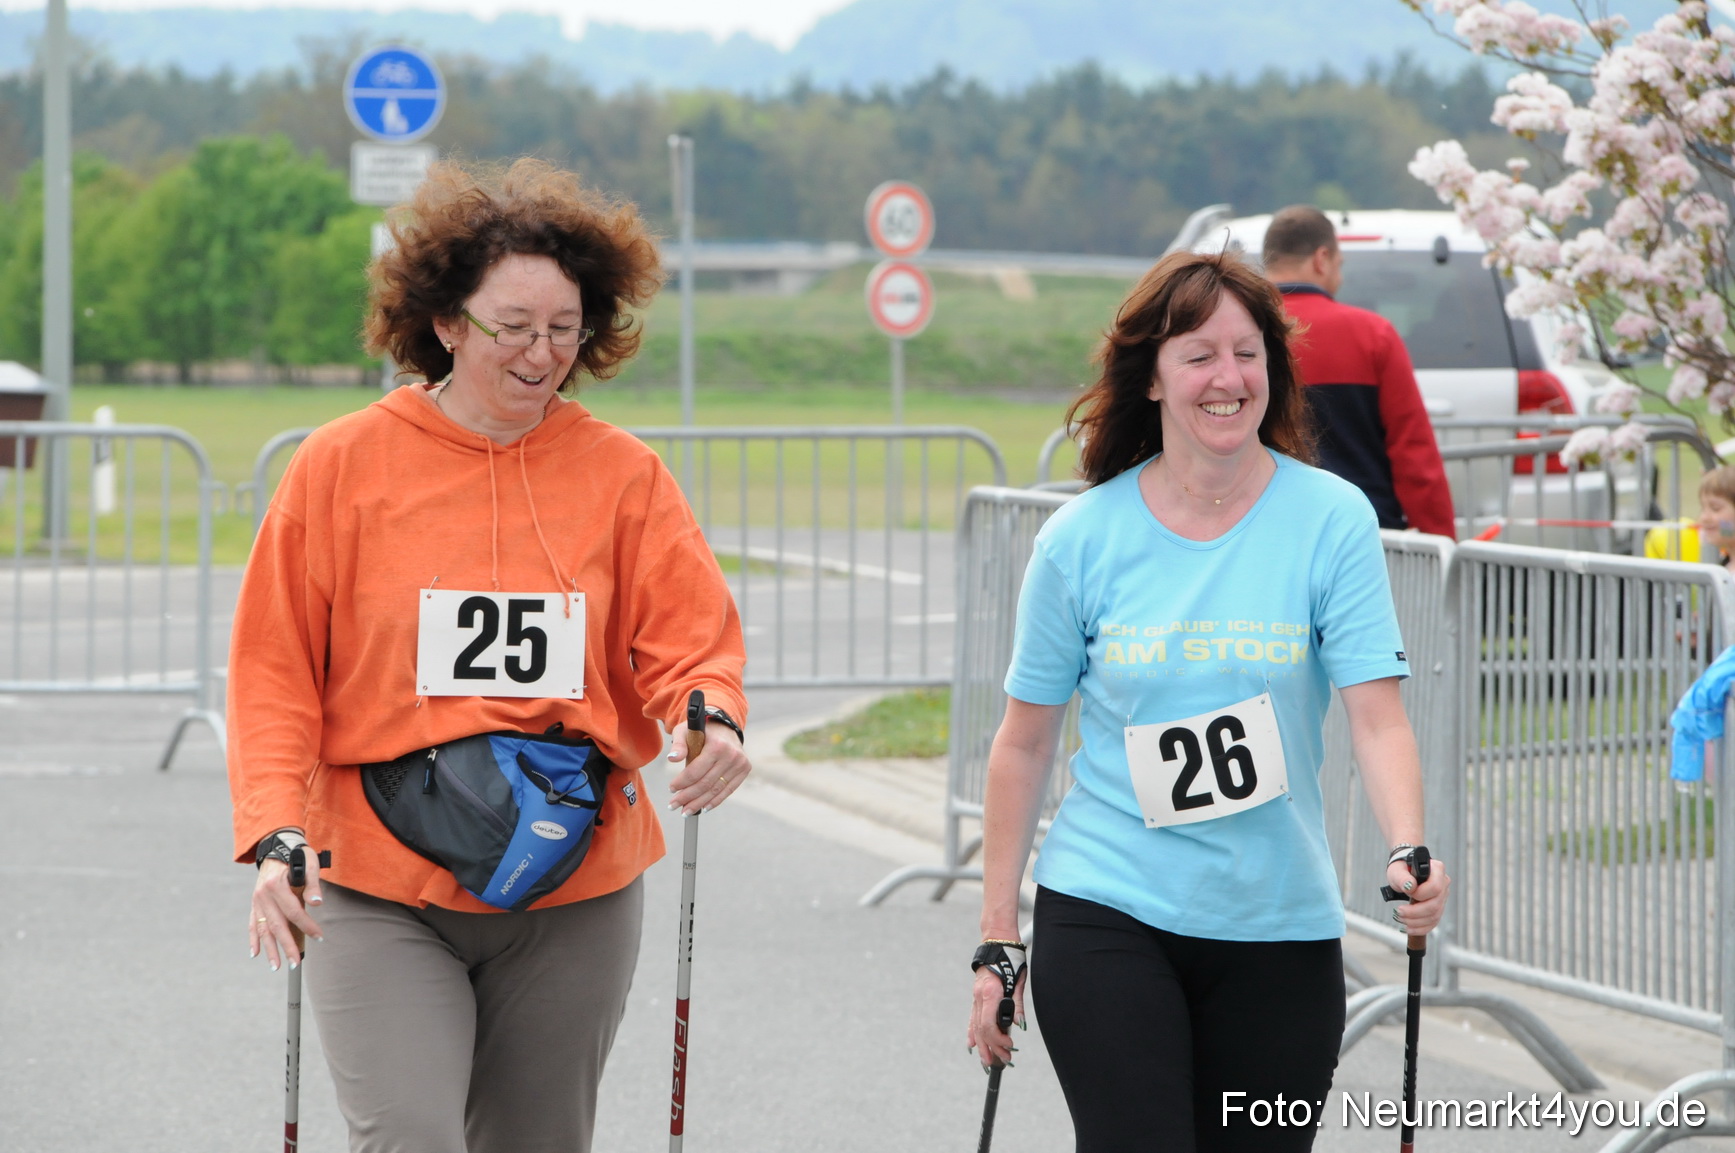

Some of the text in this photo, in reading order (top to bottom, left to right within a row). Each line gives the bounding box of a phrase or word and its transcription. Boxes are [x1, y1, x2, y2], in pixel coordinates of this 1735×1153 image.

[453, 596, 548, 684] 25
[1102, 624, 1137, 637] ICH
[1227, 619, 1264, 633] ICH
[1271, 622, 1310, 636] GEH
[1104, 638, 1309, 664] AM STOCK
[1159, 715, 1258, 812] 26
[533, 824, 565, 836] deuter
[501, 859, 529, 895] NORDIC
[671, 1015, 687, 1121] Flash
